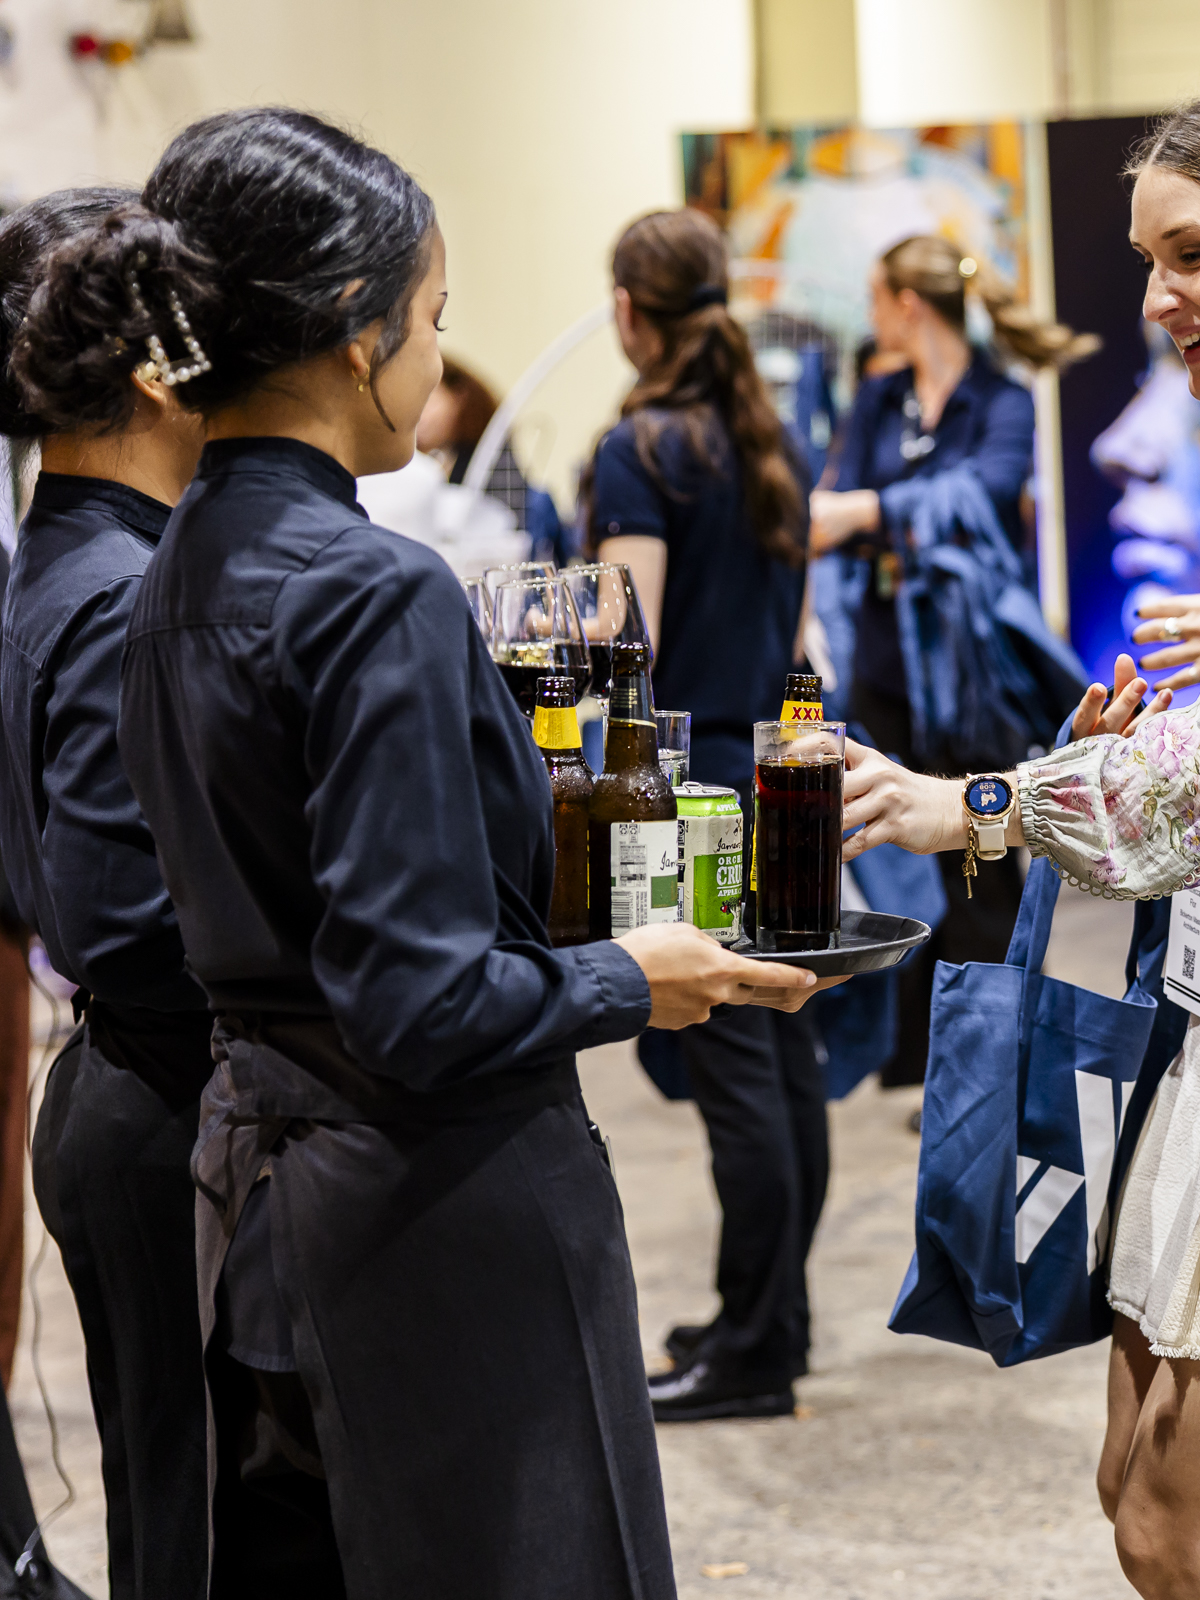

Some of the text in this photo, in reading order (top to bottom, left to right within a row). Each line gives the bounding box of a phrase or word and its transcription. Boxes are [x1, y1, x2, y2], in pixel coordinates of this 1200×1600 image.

[716, 803, 736, 812] APPLE
[717, 854, 743, 866] ORCH
[717, 888, 738, 897] APPLE
